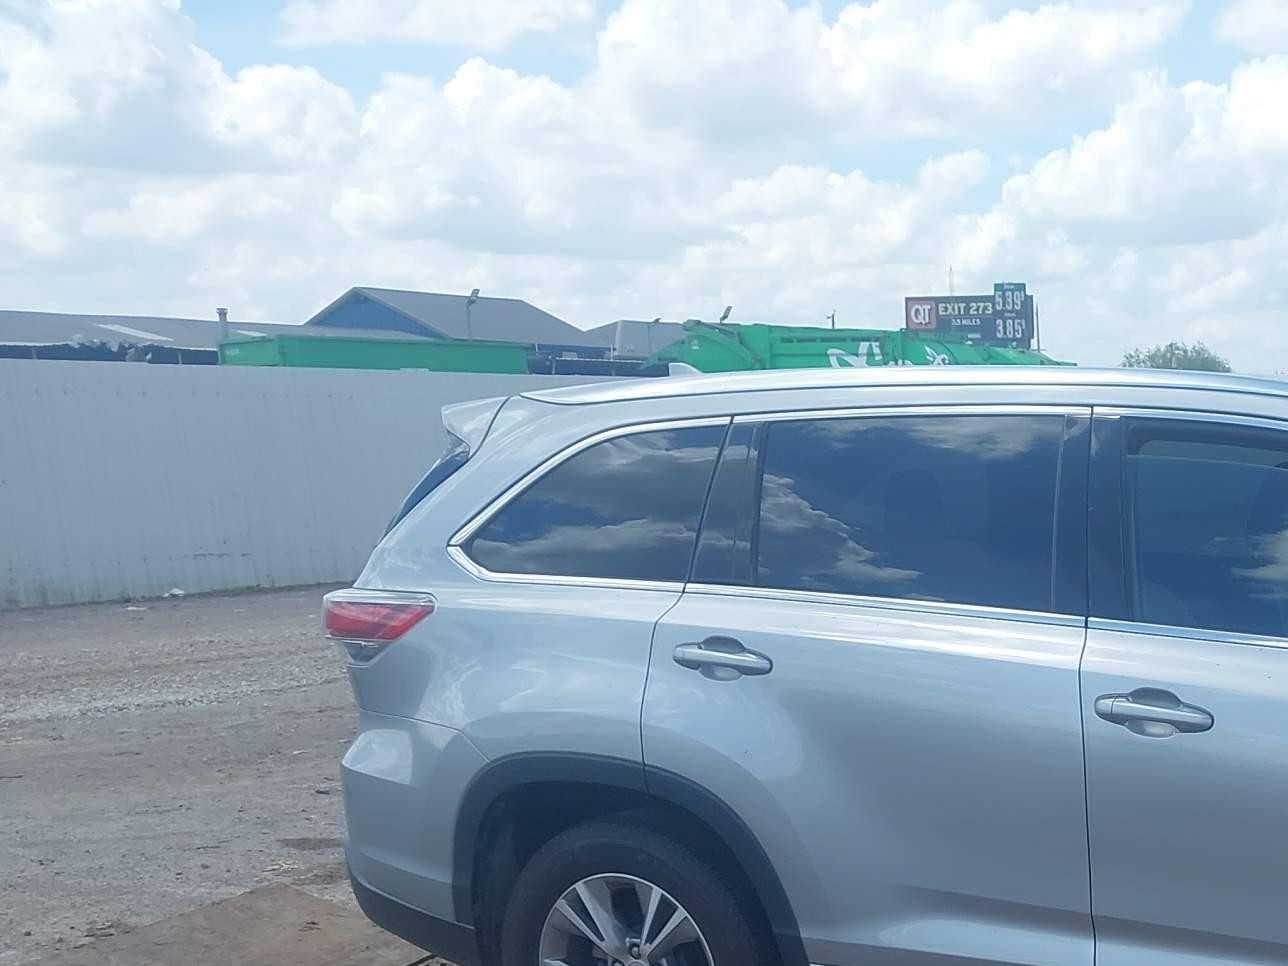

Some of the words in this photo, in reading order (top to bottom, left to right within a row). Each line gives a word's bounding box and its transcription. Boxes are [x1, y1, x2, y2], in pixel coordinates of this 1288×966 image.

[911, 304, 931, 324] QT
[938, 303, 966, 315] EXIT
[969, 302, 993, 315] 273
[962, 318, 981, 326] MILES
